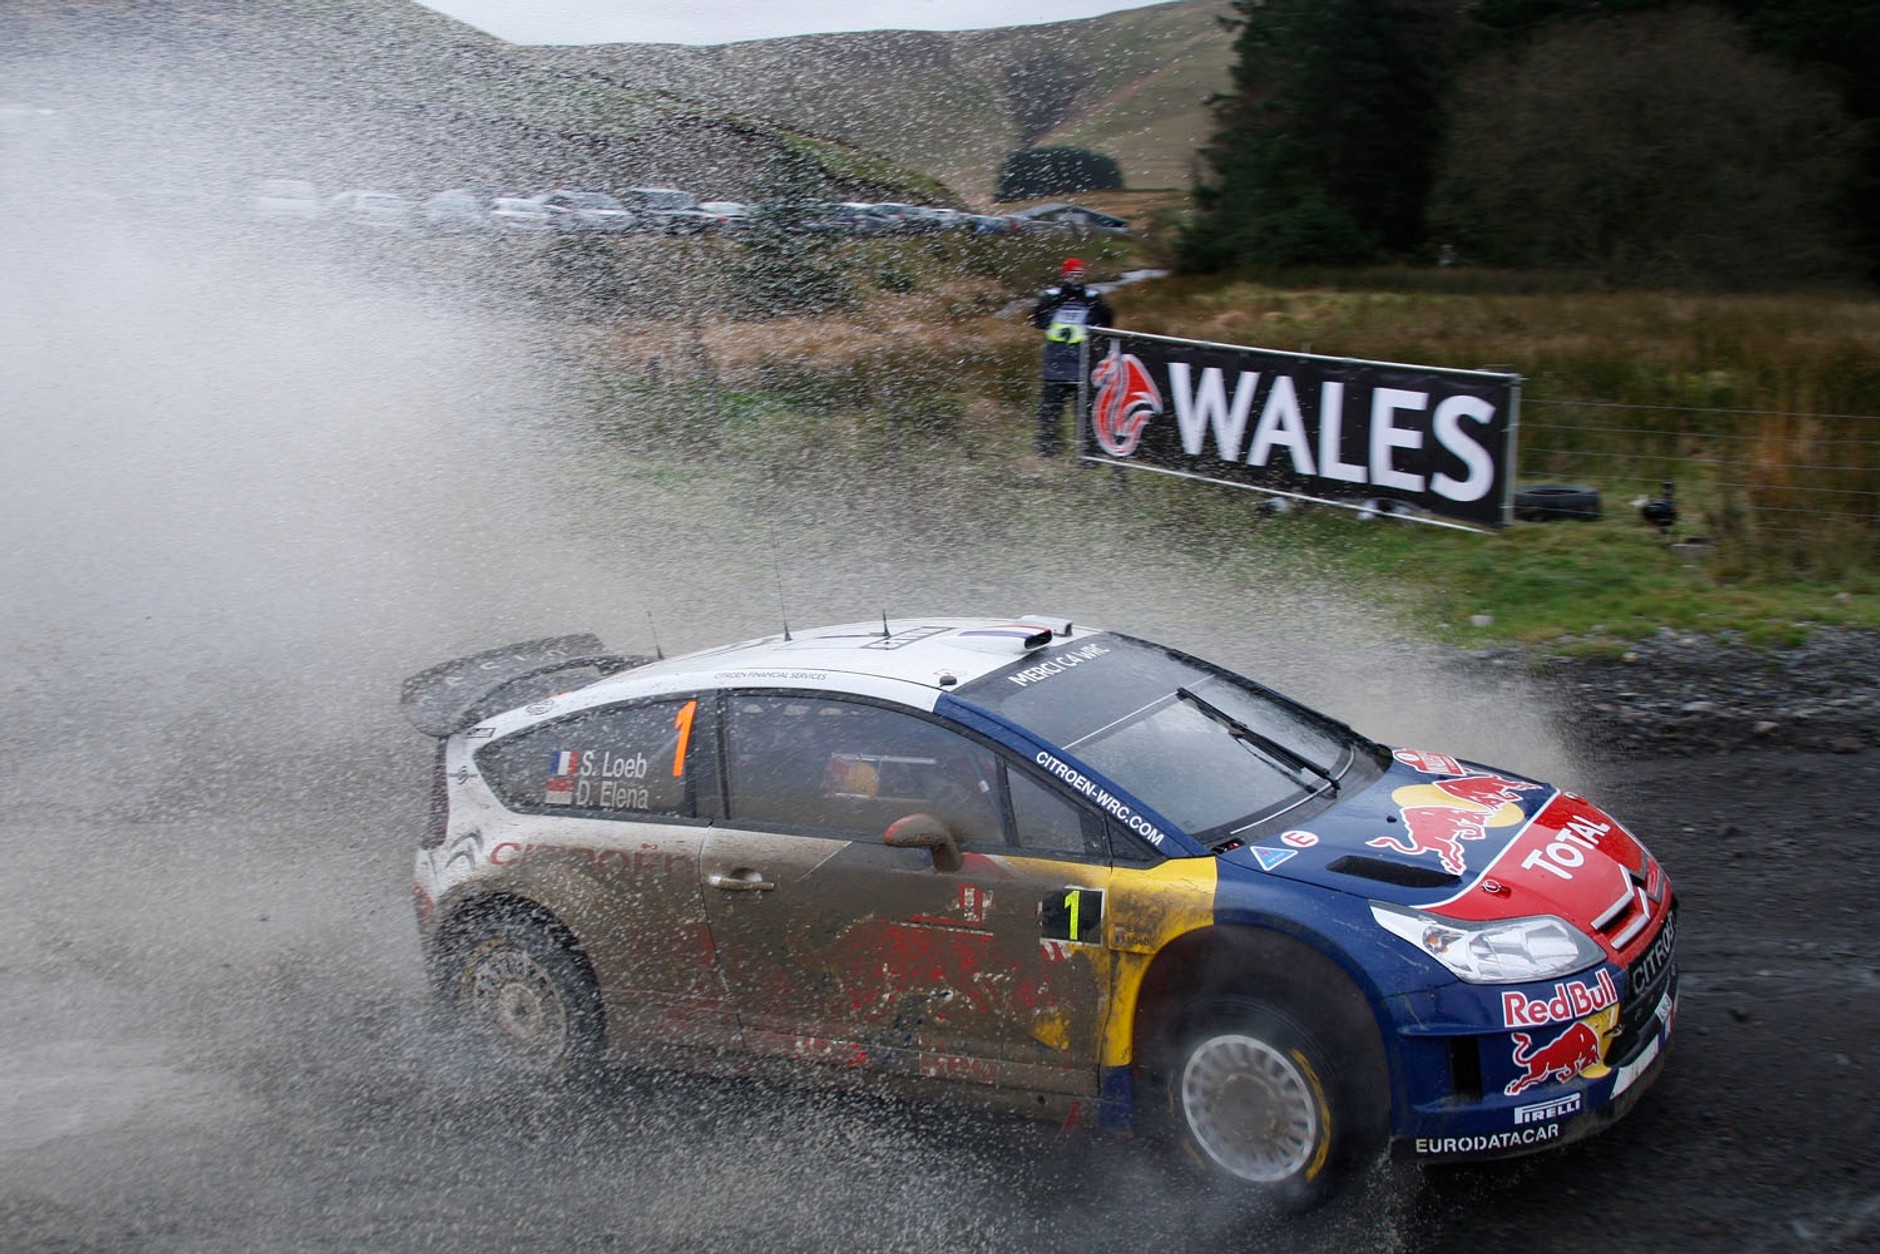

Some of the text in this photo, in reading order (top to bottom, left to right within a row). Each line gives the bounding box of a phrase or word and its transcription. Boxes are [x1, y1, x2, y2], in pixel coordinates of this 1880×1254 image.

[1166, 362, 1497, 503] WALES
[790, 672, 828, 681] SERVICES
[1007, 660, 1067, 688] MERCI
[672, 699, 698, 778] 1
[579, 750, 648, 779] S. Loeb
[575, 780, 650, 809] D. Elena
[1036, 751, 1165, 846] CITROEN-WRC.COM
[1284, 832, 1315, 846] E
[1520, 815, 1611, 880] TOTAL
[1064, 889, 1081, 941] 1
[1502, 983, 1573, 1028] Red
[1566, 967, 1618, 1018] Bull
[1514, 1093, 1581, 1125] PIRELLI
[1416, 1123, 1559, 1153] EURODATACAR
